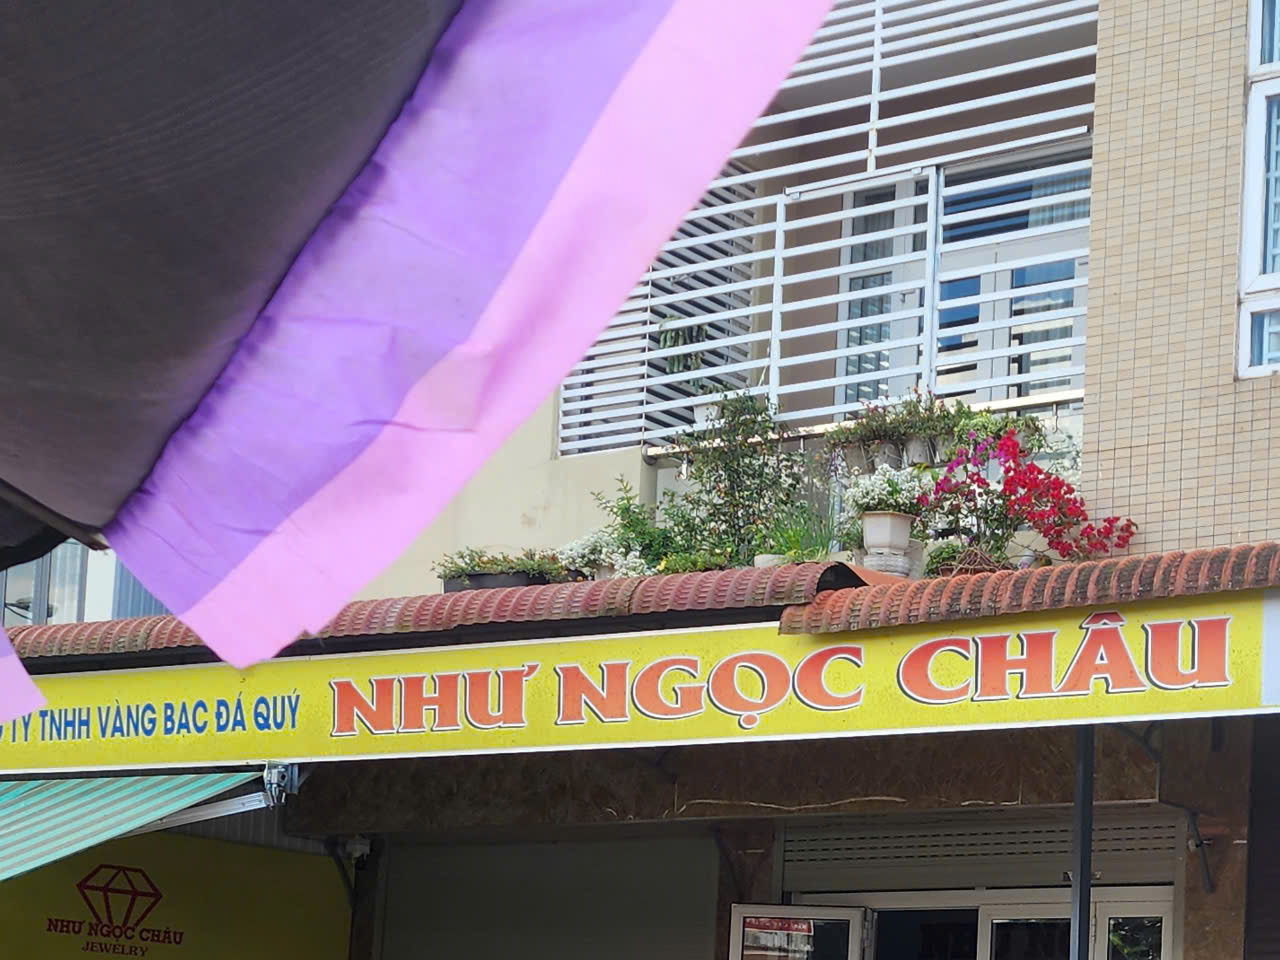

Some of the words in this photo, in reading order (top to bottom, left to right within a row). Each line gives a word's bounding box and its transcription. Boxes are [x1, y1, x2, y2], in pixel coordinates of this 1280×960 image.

[330, 661, 540, 738] NHƯ
[553, 643, 866, 730] NGỌC
[897, 610, 1232, 705] CHÂU
[39, 706, 91, 742] TNHH
[97, 698, 158, 739] VÀNG
[163, 699, 208, 738] BẠC
[215, 690, 247, 733] ĐÁ
[253, 687, 301, 732] QUÝ
[47, 918, 86, 936] NHƯ
[87, 922, 136, 942] NGỌC
[139, 927, 184, 945] CHÂU
[82, 941, 148, 957] JEWELRY
